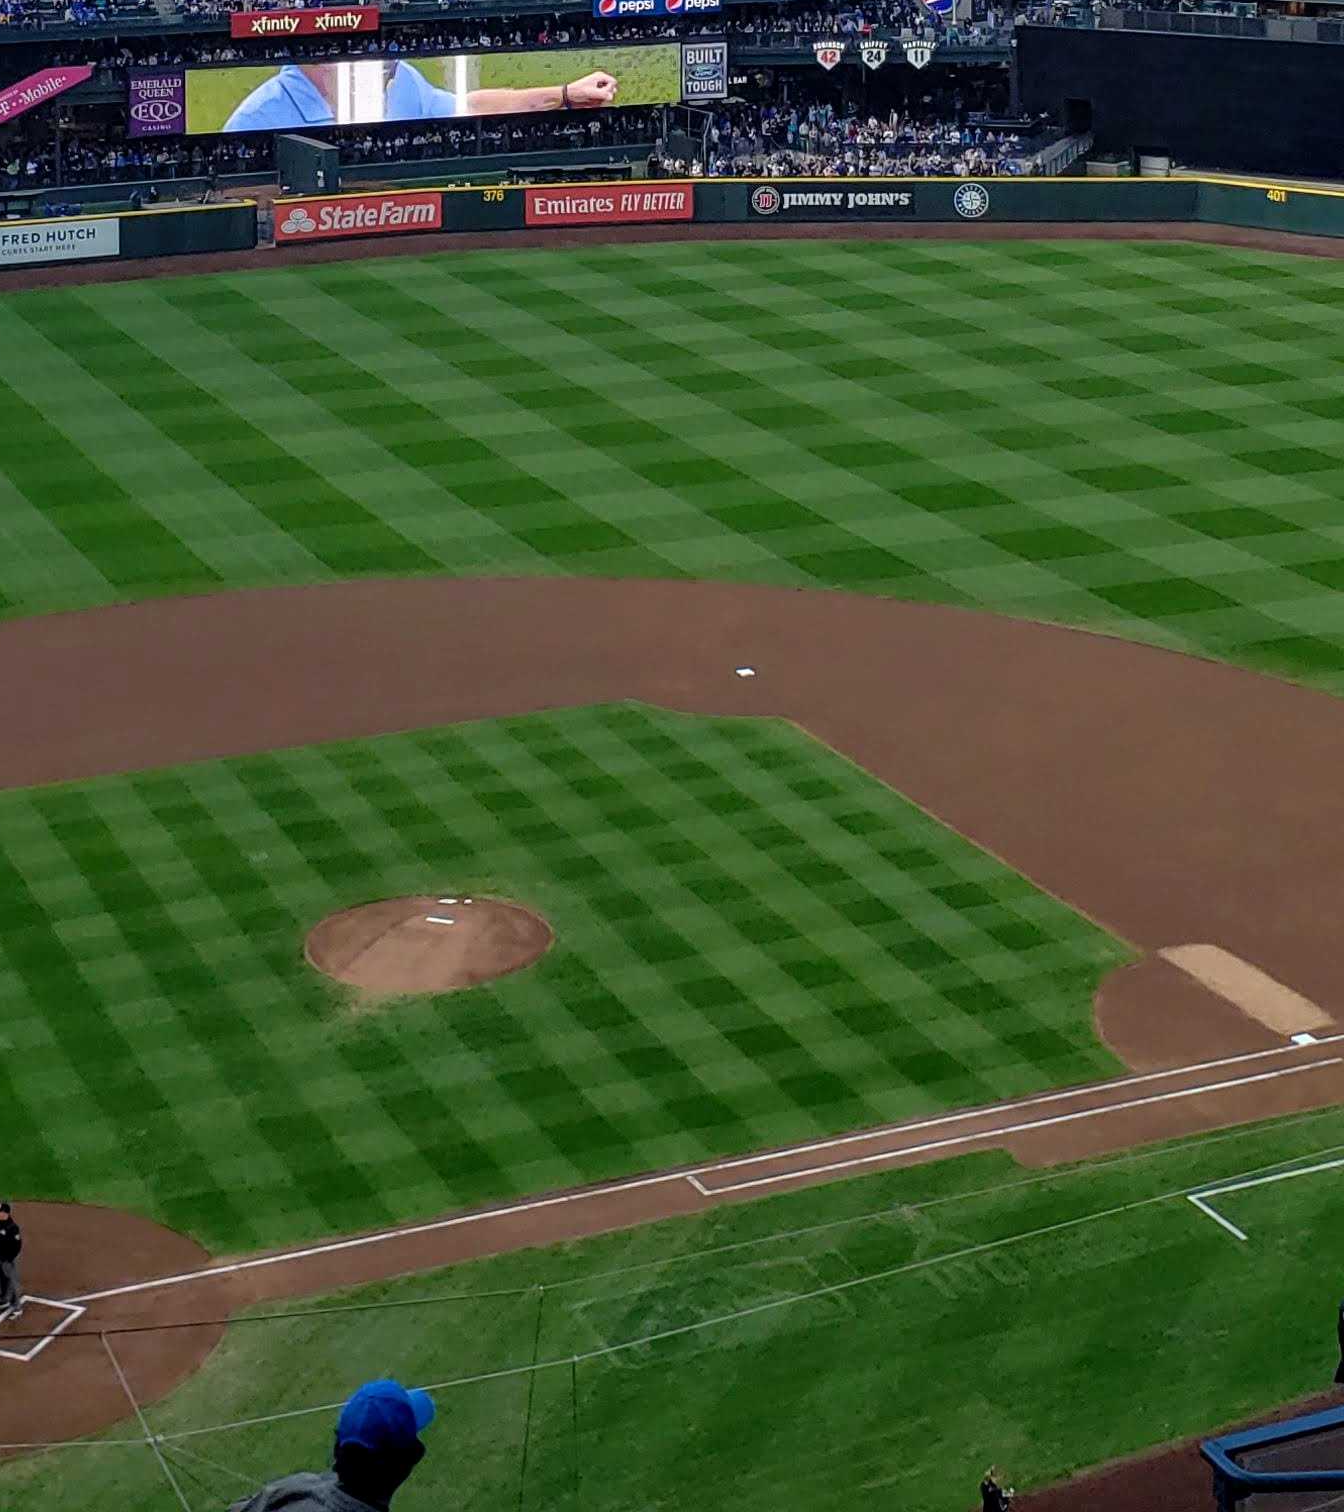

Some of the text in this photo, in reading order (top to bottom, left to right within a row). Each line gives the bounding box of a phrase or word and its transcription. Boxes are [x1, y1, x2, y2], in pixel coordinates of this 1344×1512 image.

[251, 15, 301, 34] xfinity
[314, 12, 362, 30] xfinity
[686, 48, 723, 65] BUILT
[820, 50, 837, 63] 42
[866, 50, 882, 63] 24
[914, 50, 925, 63] 11
[131, 78, 182, 89] EMERALD
[686, 80, 723, 93] TOUGH
[139, 88, 174, 99] QUEEN
[138, 100, 180, 121] EQC
[483, 190, 504, 202] 376
[783, 192, 912, 209] JIMMY JOHN'S
[1267, 189, 1286, 202] 401
[534, 192, 685, 215] Emirates FLY BETTER
[1, 228, 96, 246] FRED HUTCH
